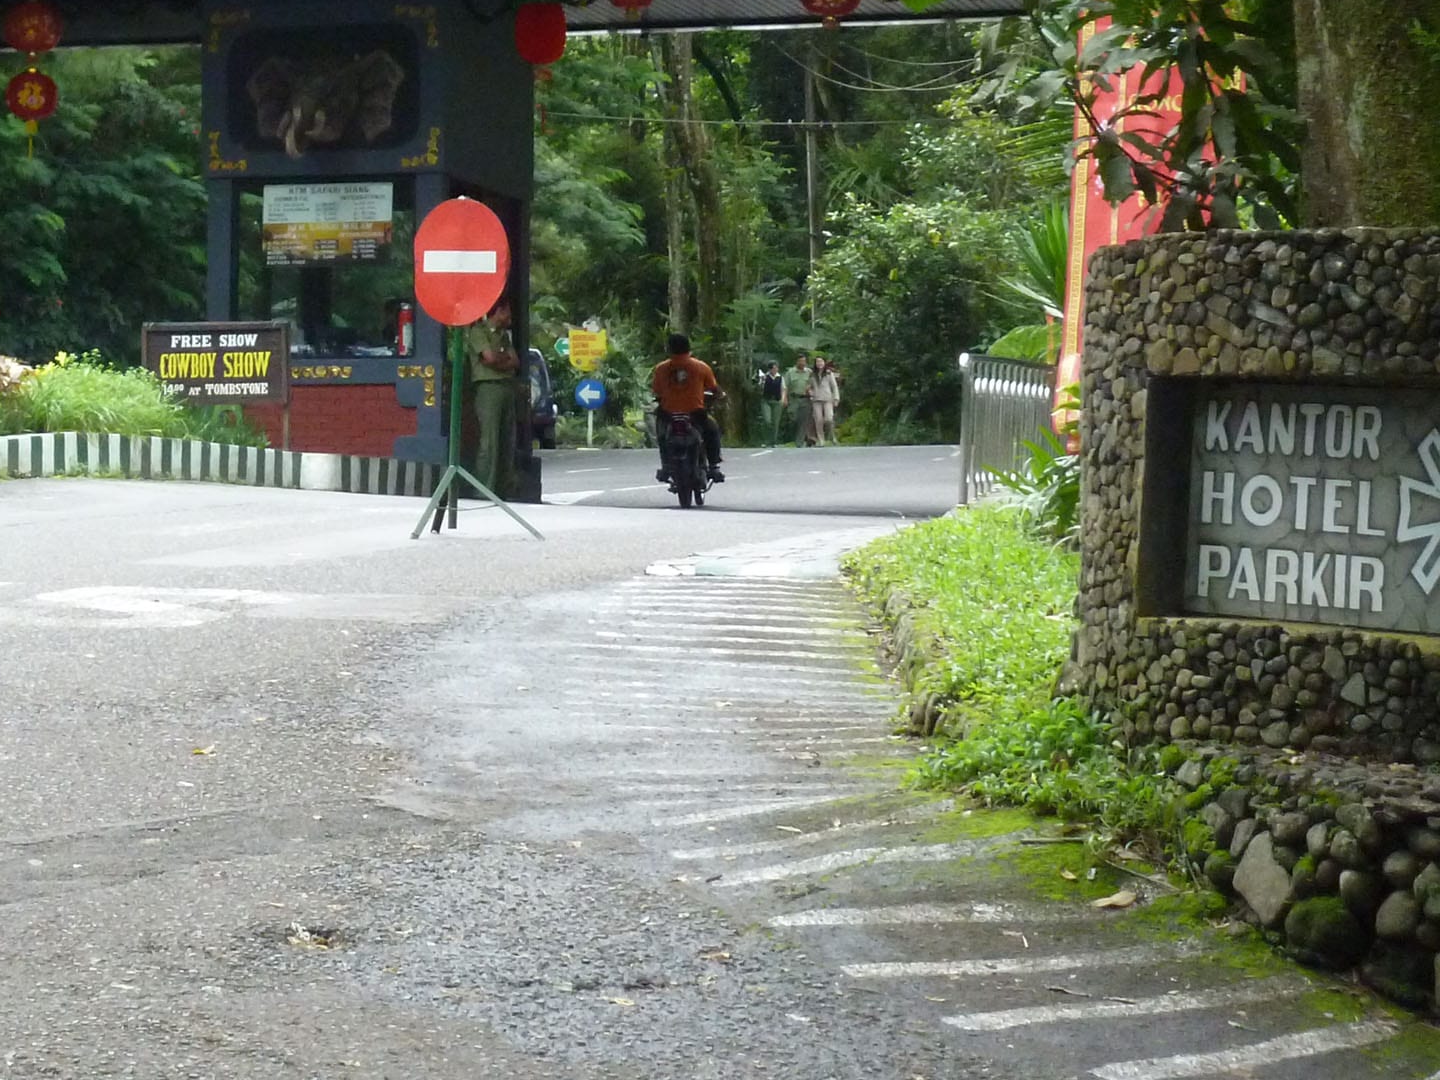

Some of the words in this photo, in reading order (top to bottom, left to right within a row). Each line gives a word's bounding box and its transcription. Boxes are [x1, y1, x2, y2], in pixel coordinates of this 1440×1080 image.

[171, 334, 212, 348] FREE
[219, 333, 258, 348] SHOW
[160, 352, 217, 379] COWBOY
[223, 351, 271, 378] SHOW
[205, 382, 269, 395] TOMBSTONE
[1205, 400, 1383, 461] KANTOR
[1201, 471, 1386, 537] HOTEL
[1197, 544, 1385, 612] PARKIR
